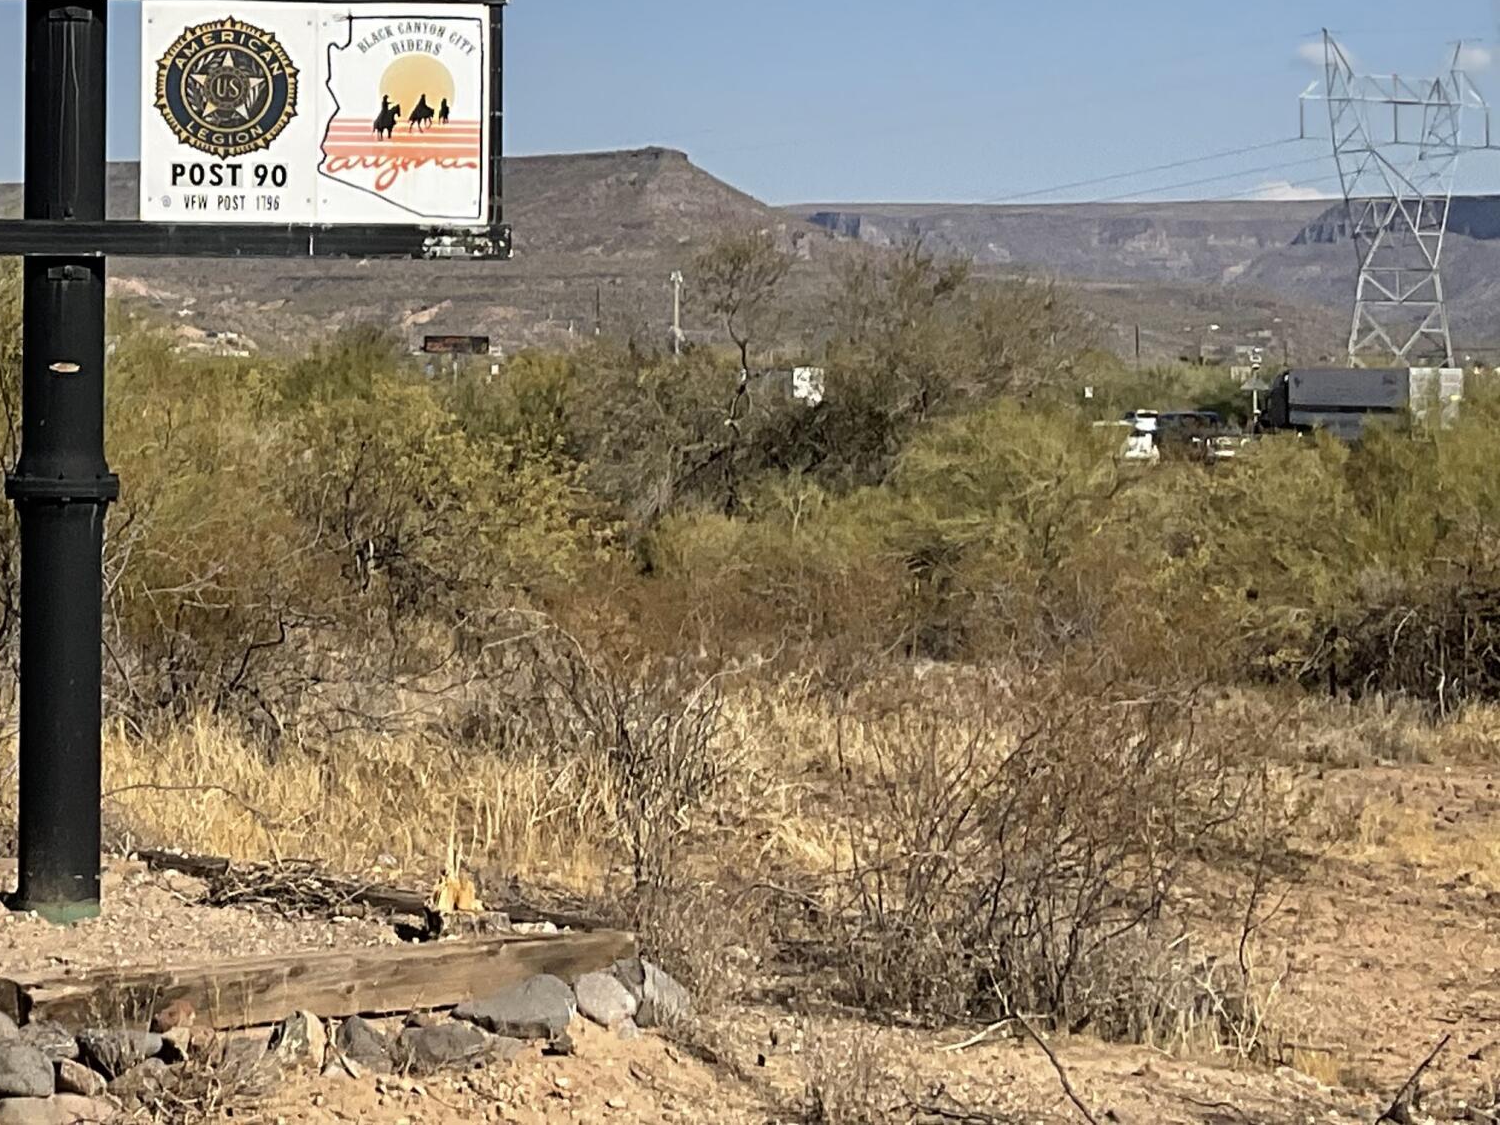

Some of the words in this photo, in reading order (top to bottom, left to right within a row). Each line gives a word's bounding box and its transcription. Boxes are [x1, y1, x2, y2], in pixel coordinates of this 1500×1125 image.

[357, 25, 395, 54] BLACK
[398, 22, 446, 38] CANYON
[449, 31, 477, 56] CITY
[391, 39, 442, 56] RIDERS
[175, 31, 284, 76] AMERICAN
[216, 77, 240, 98] US
[186, 123, 264, 144] LEGION
[171, 163, 242, 186] POST
[254, 164, 287, 187] 90
[326, 154, 478, 191] arizona
[184, 194, 208, 210] VFW
[218, 195, 245, 210] POST
[256, 195, 280, 211] 1796
